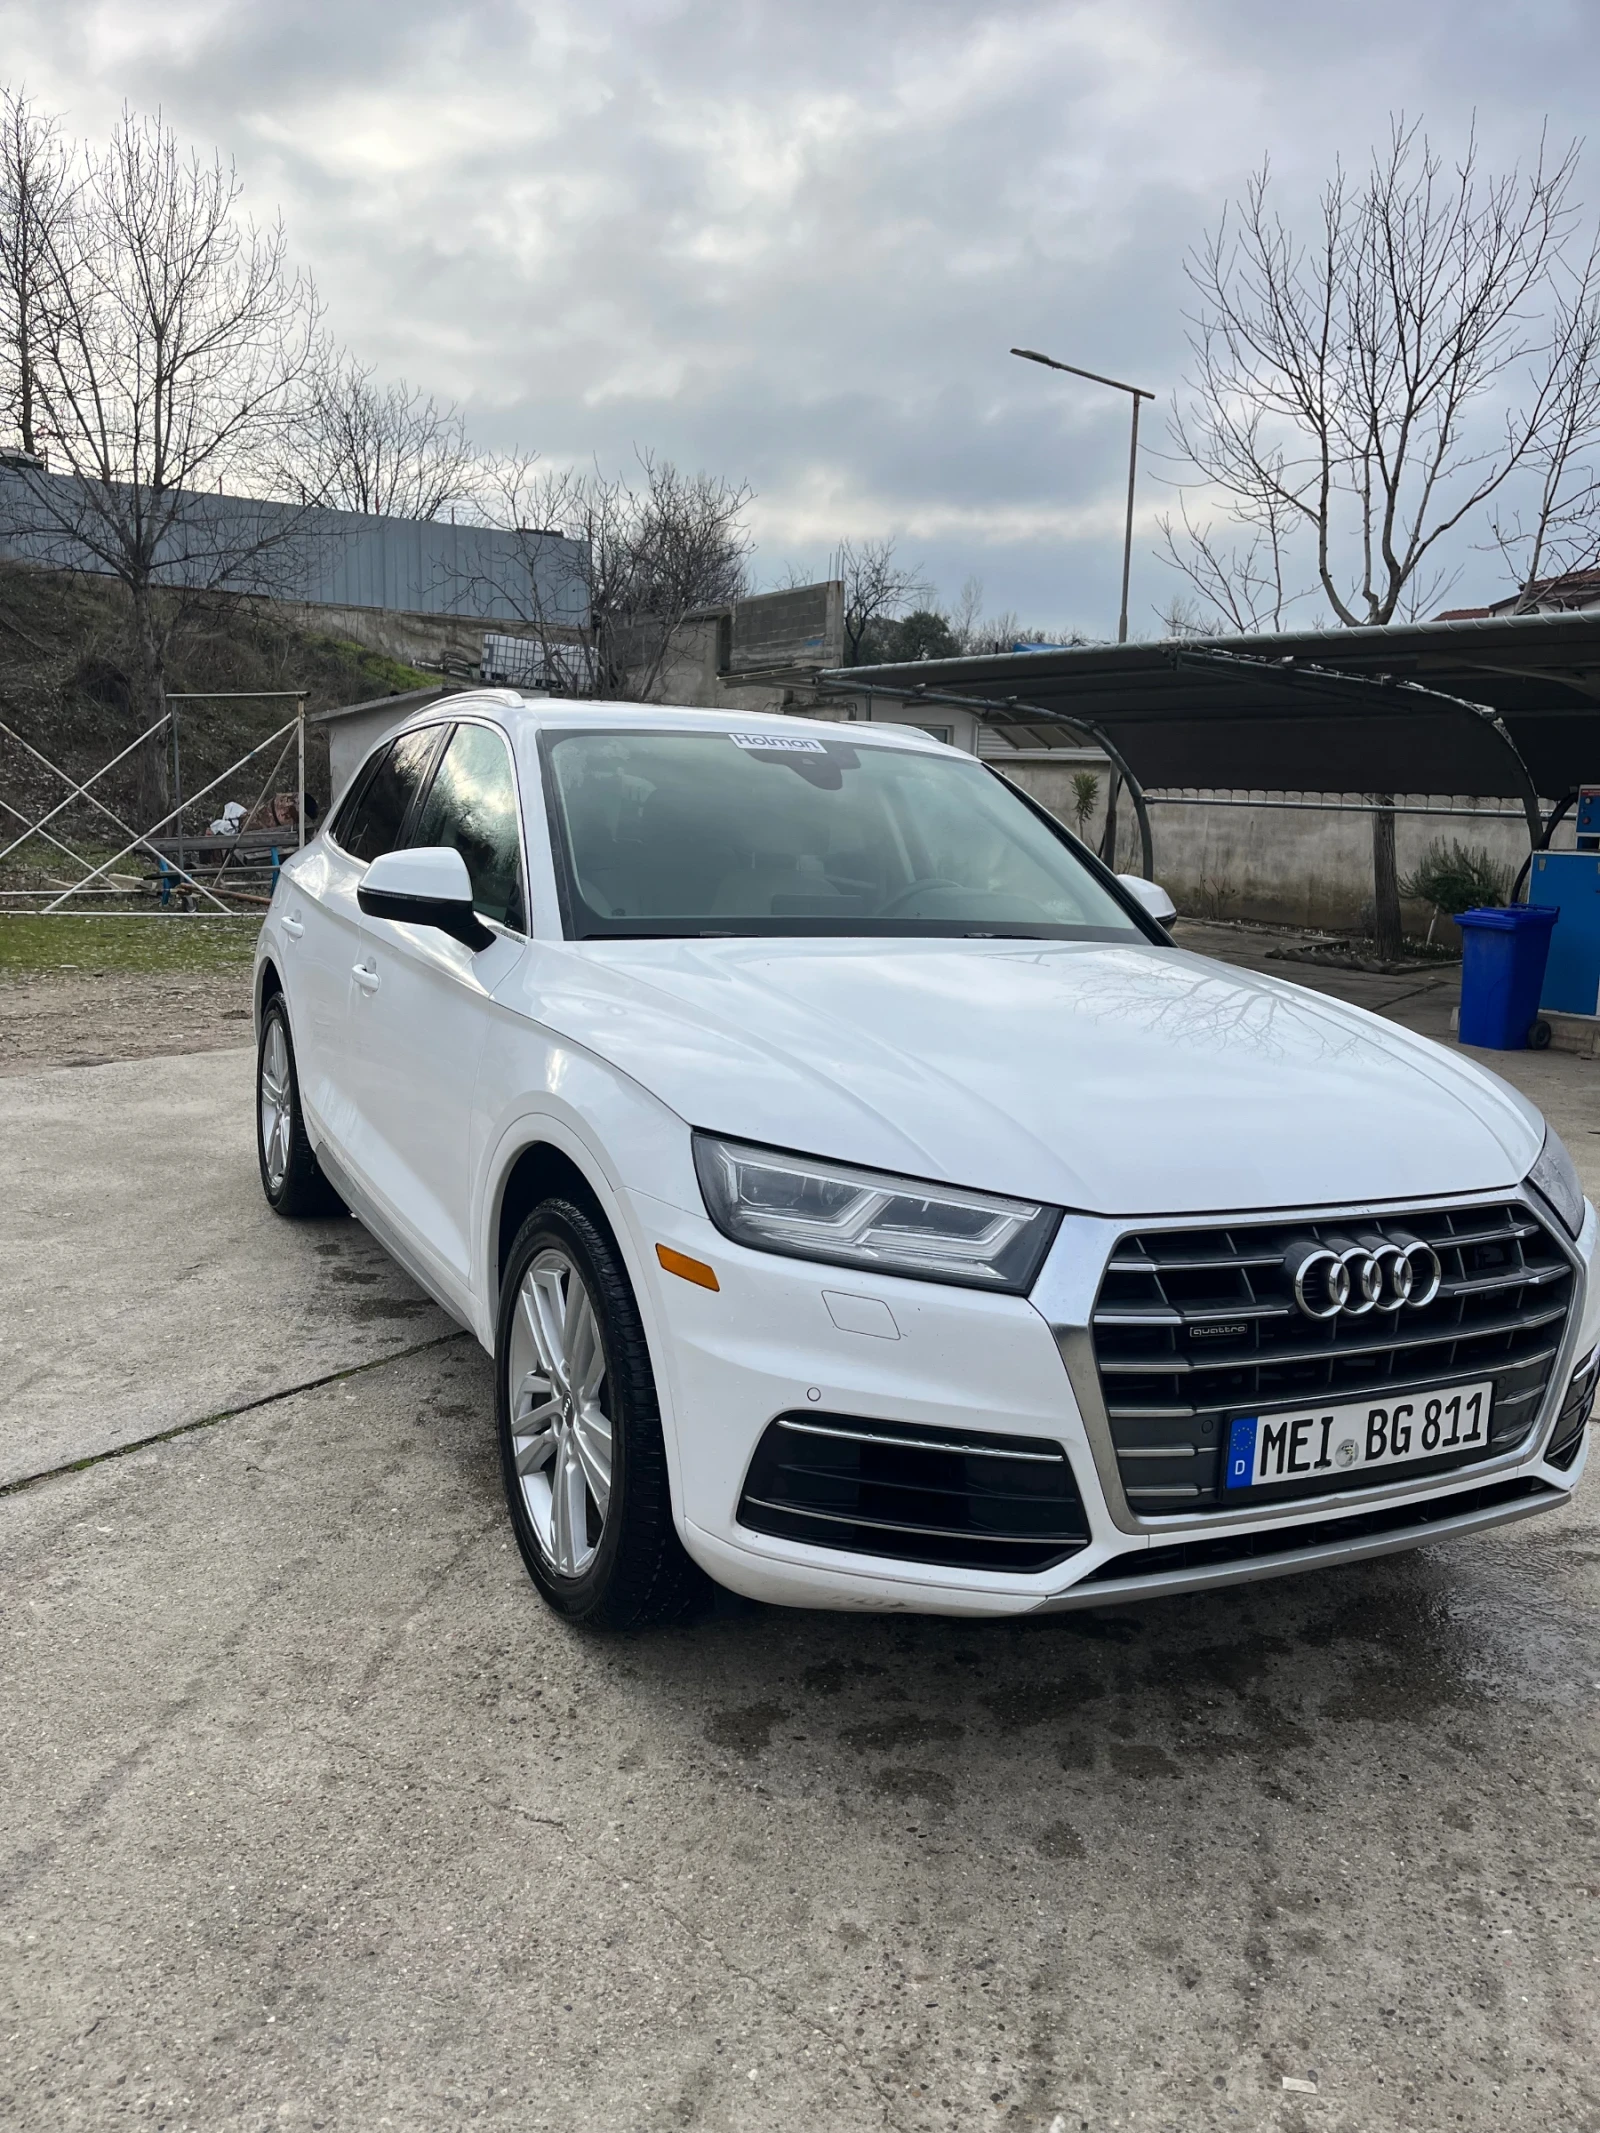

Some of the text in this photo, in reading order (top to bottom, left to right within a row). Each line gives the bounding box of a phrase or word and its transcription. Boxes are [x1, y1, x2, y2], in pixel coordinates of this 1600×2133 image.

[733, 734, 820, 749] Holman
[1193, 1326, 1246, 1336] quattro
[1260, 1392, 1483, 1476] MEI BG 811
[1234, 1460, 1245, 1475] D
